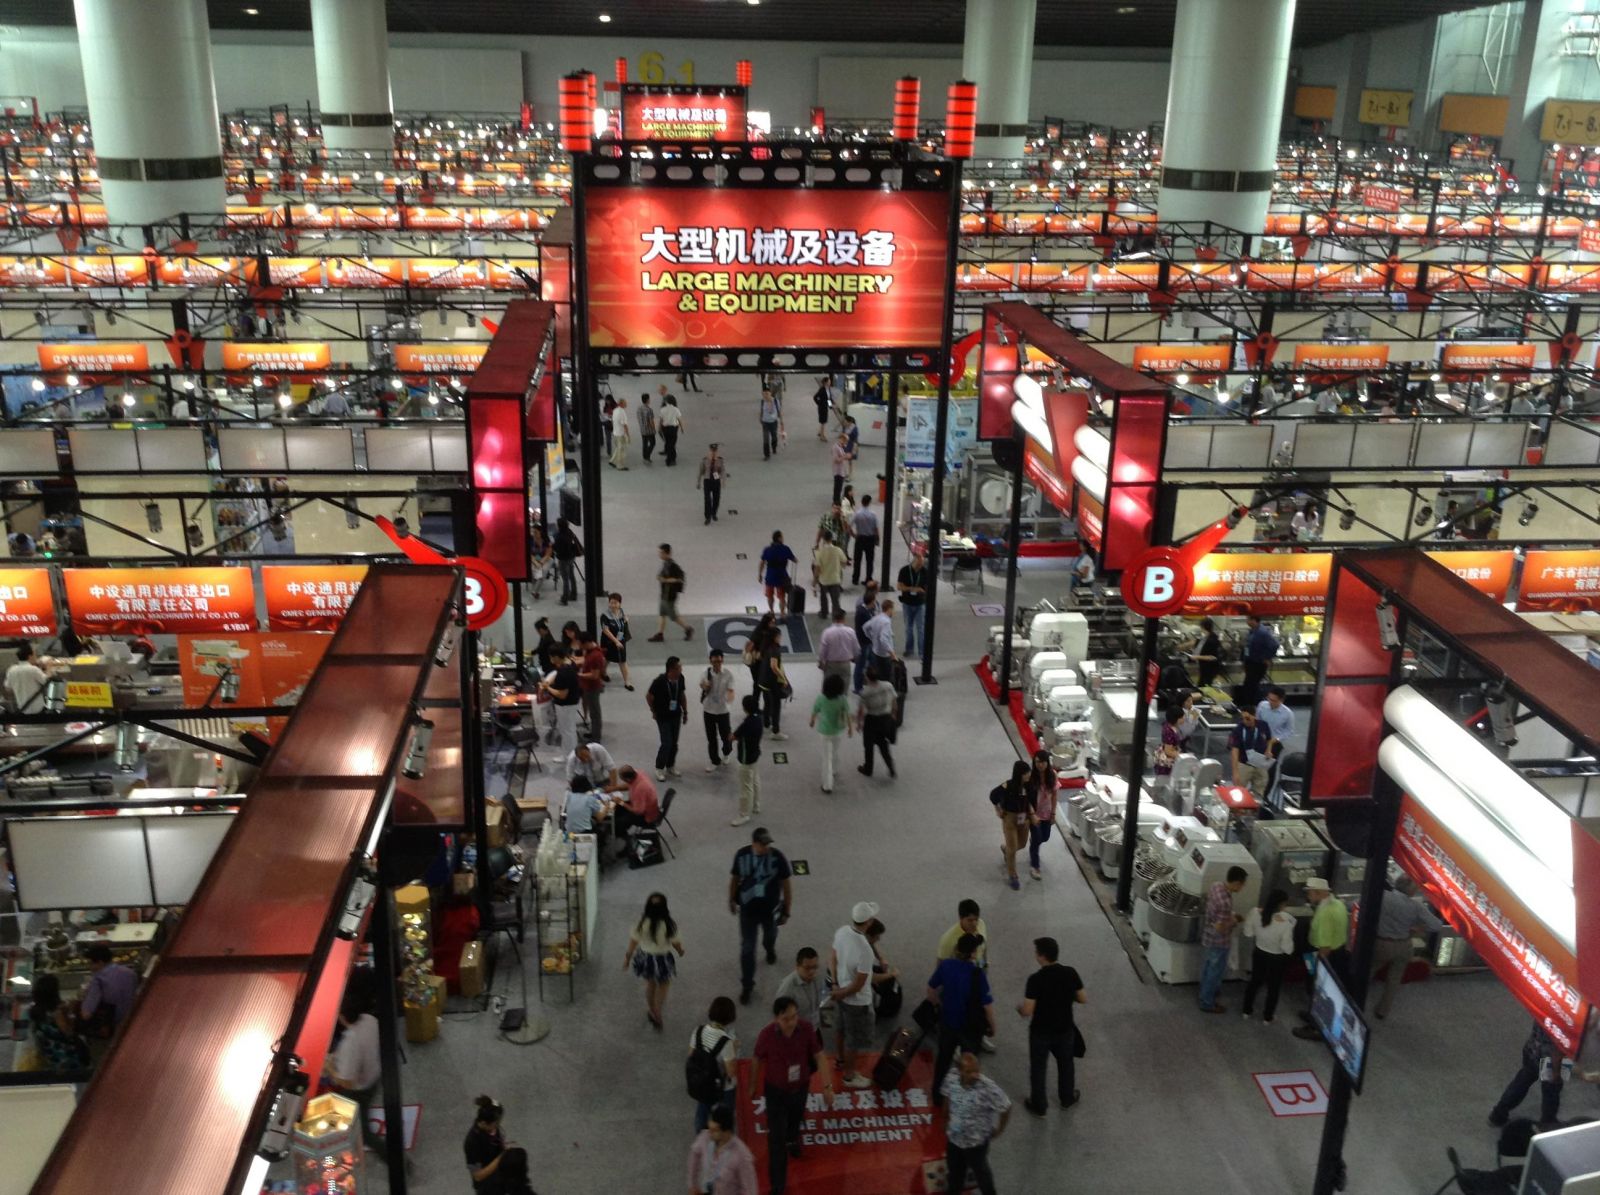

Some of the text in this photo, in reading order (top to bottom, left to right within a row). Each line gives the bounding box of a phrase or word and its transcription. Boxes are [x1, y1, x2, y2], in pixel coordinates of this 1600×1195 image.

[638, 51, 695, 85] 6.1
[641, 107, 727, 123] 大型机械及设备
[641, 123, 727, 131] LARGE MACHINERY
[664, 130, 715, 138] EQUIPMENT
[640, 226, 896, 267] 大型机械及设备
[641, 271, 894, 294] LARGE MACHINERY
[678, 293, 857, 314] & EQUIPMENT
[88, 583, 231, 600] 中设通用机械进出口
[1143, 566, 1175, 603] B
[1231, 583, 1281, 595] 有限公司
[116, 598, 210, 613] 有限责任公司
[282, 609, 341, 618] CMEC GENERAL
[85, 613, 109, 621] CMEC
[109, 613, 147, 621] GENERAL
[149, 612, 194, 621] MACHINERY
[1271, 1082, 1317, 1106] B
[823, 1113, 934, 1131] MACHINERY
[803, 1129, 913, 1146] EQUIPMENT
